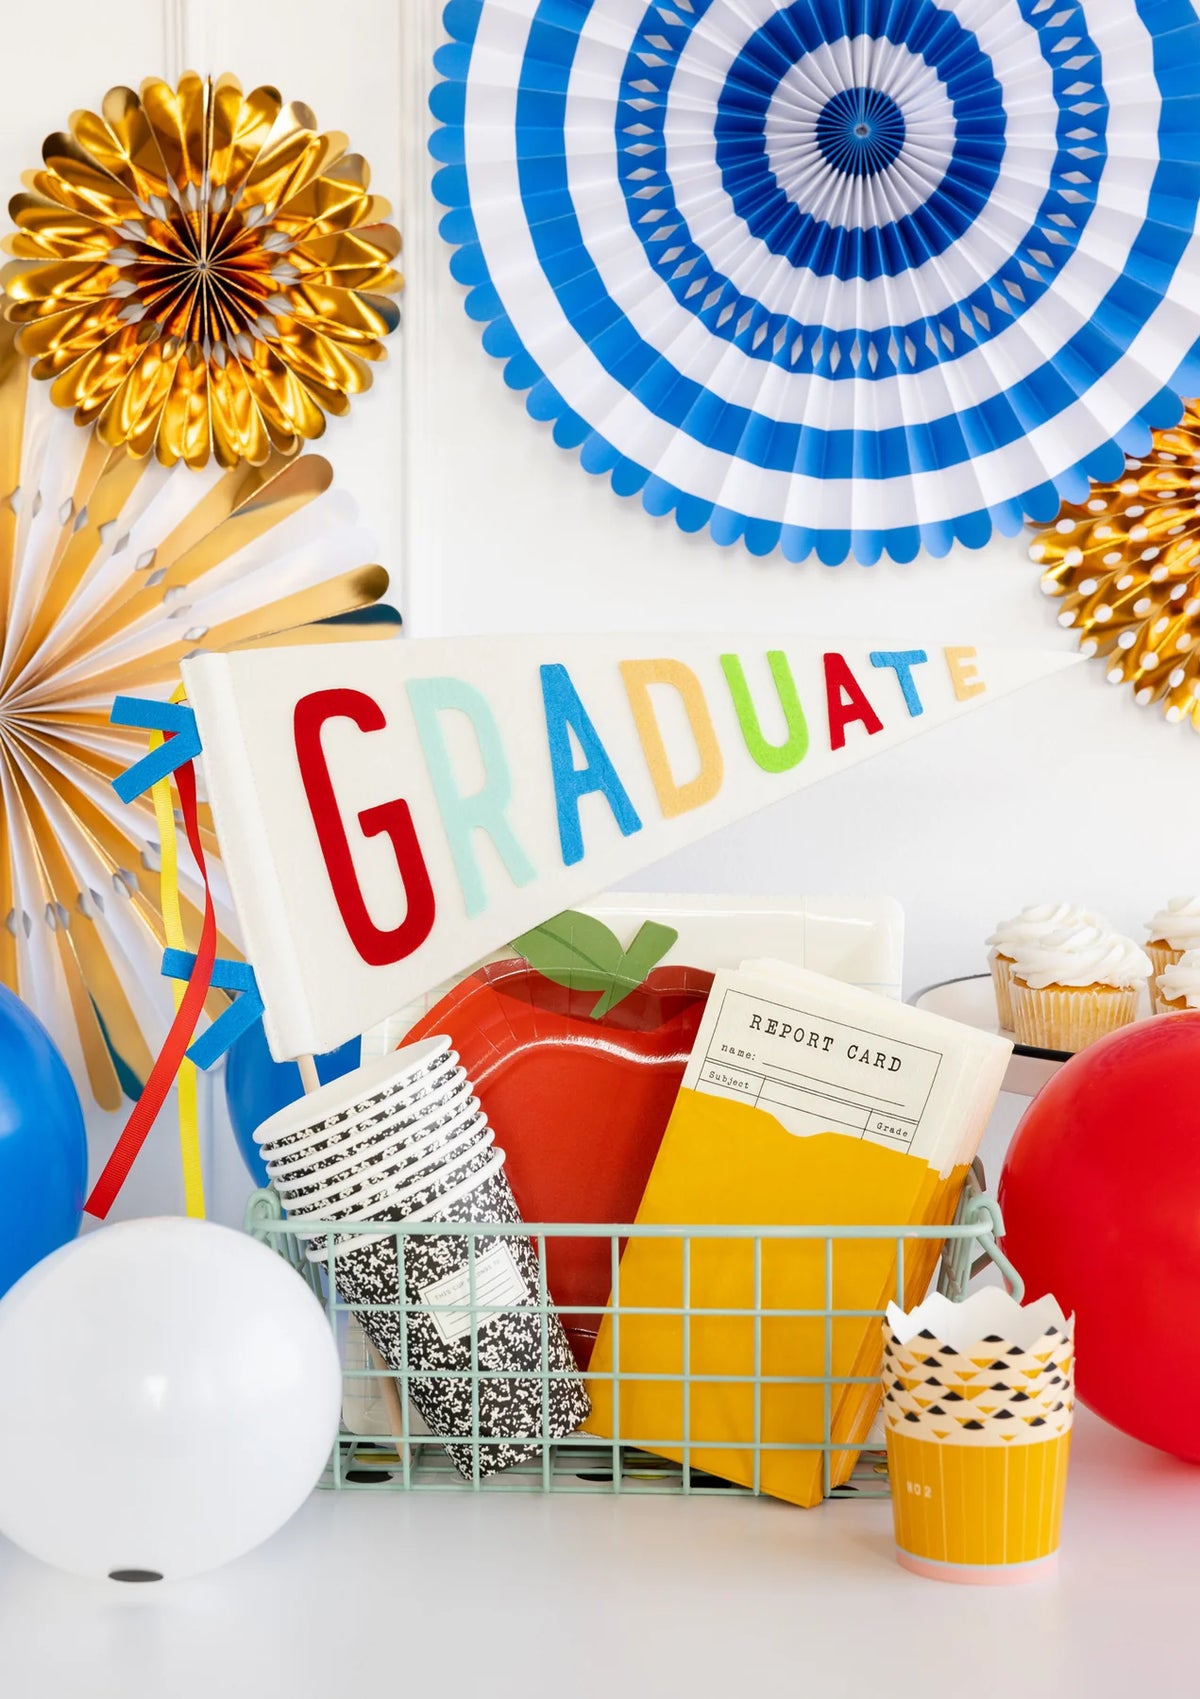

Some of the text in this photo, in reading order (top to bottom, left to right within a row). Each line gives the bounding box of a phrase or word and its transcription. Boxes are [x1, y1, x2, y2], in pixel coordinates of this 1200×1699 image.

[292, 646, 987, 967] GRADUATE
[720, 1043, 756, 1061] name:
[749, 1013, 902, 1073] REPORT CARD
[708, 1070, 750, 1090] Subject
[876, 1122, 909, 1138] Grade
[924, 1485, 932, 1499] 2
